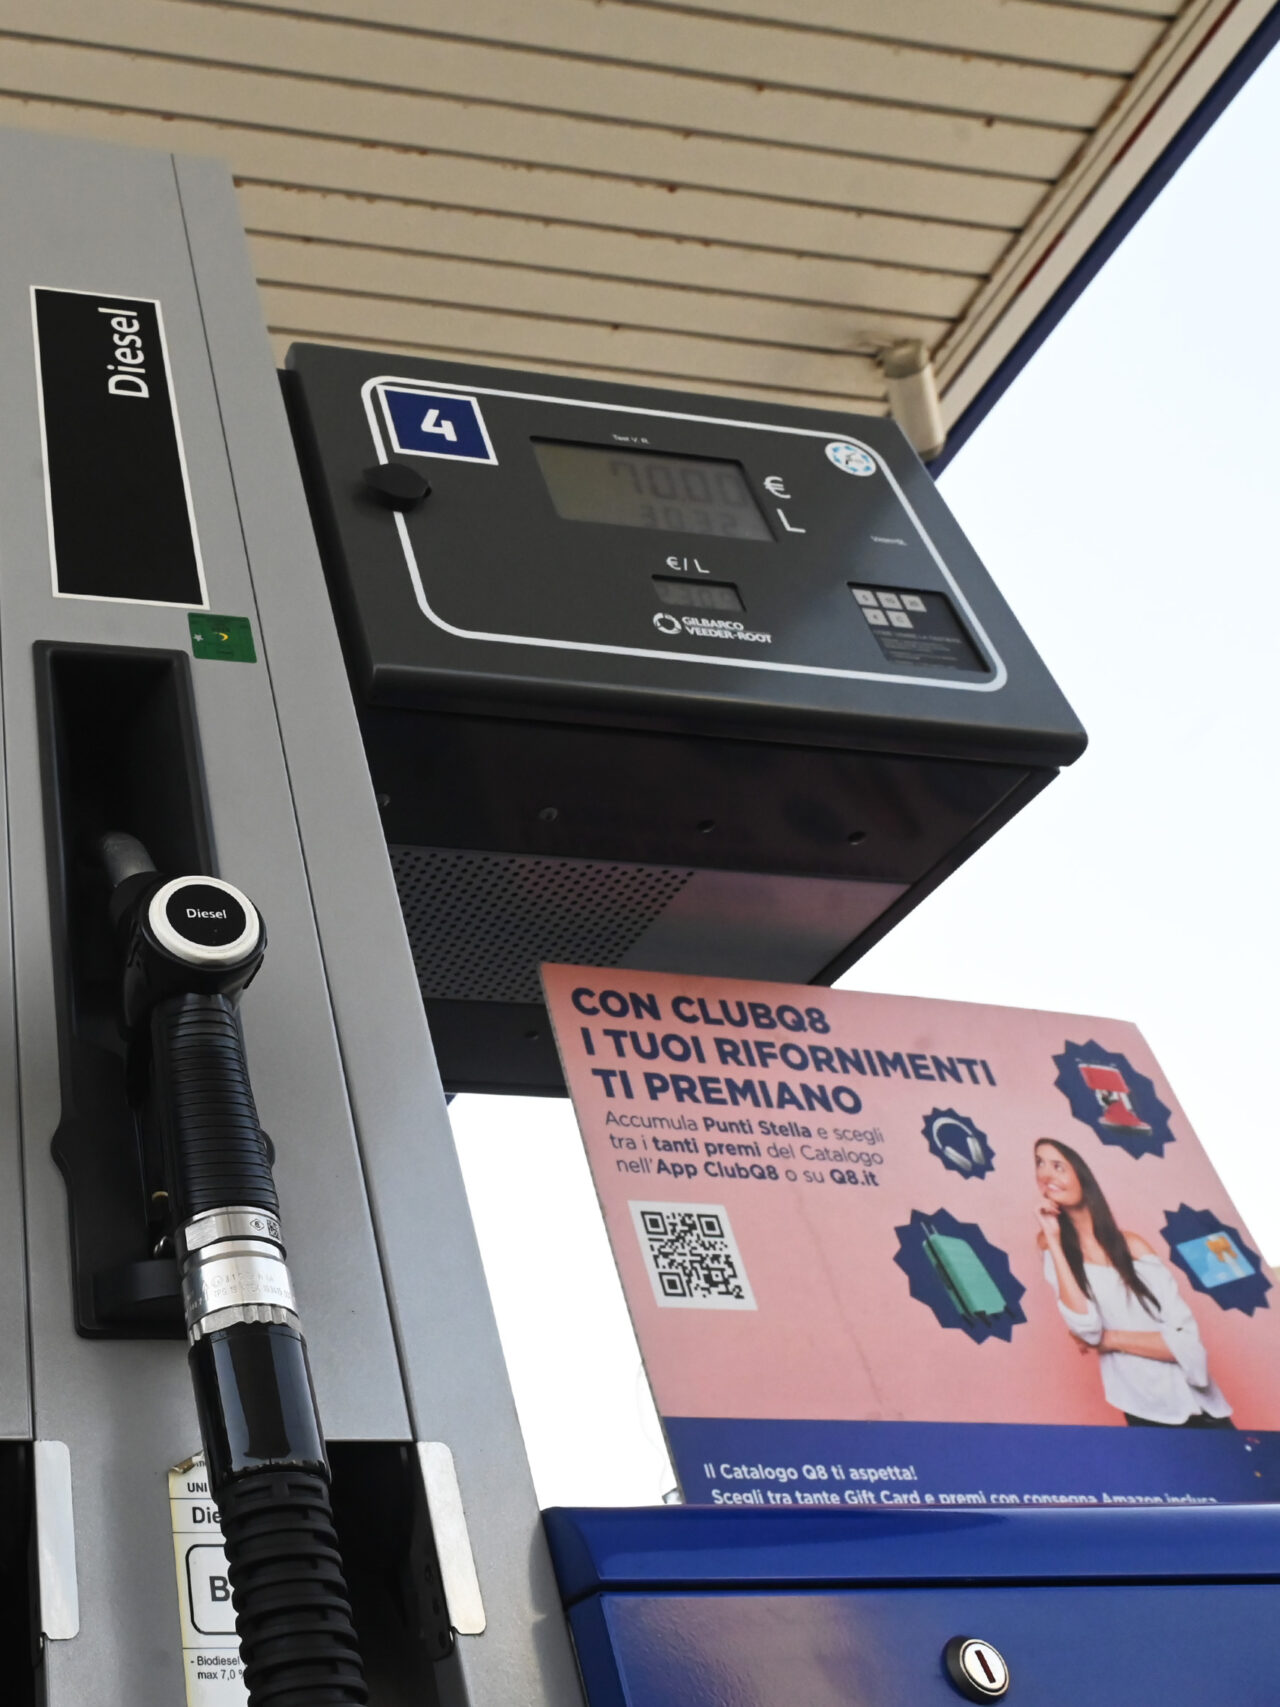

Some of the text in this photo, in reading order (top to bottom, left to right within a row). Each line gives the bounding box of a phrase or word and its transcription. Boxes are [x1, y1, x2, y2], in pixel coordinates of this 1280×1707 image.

[97, 307, 150, 399] Diesel
[421, 408, 458, 442] 4
[776, 508, 807, 534] L
[681, 616, 745, 632] GILBARCO
[684, 626, 773, 644] VEEDER-ROOT
[186, 908, 227, 919] Diesel
[571, 987, 831, 1035] CON CLUBQ8
[579, 1026, 997, 1087] I TUOI RIFORNIMENTI
[591, 1068, 862, 1115] TI PREMIANO
[605, 1110, 885, 1146] Accumula Punti Stella e scegli
[609, 1133, 884, 1166] tra i tanti premi del Catalogo
[703, 1161, 780, 1182] ClubQ8
[785, 1169, 798, 1182] o
[803, 1170, 826, 1185] su
[829, 1169, 880, 1188] Q8.it
[703, 1462, 918, 1483] Il Catalogo Q8 ti aspetta!
[187, 1482, 208, 1493] UNI
[711, 1488, 765, 1504] Scegli
[767, 1490, 792, 1504] tra
[794, 1490, 841, 1504] tante
[844, 1489, 875, 1504] Gift
[879, 1490, 920, 1504] Card
[924, 1493, 935, 1504] e
[938, 1490, 987, 1504] premi
[192, 1506, 221, 1524] Die
[209, 1575, 230, 1602] B
[197, 1655, 240, 1666] Biodiesel
[197, 1671, 218, 1680] max
[220, 1669, 236, 1681] 7,0
